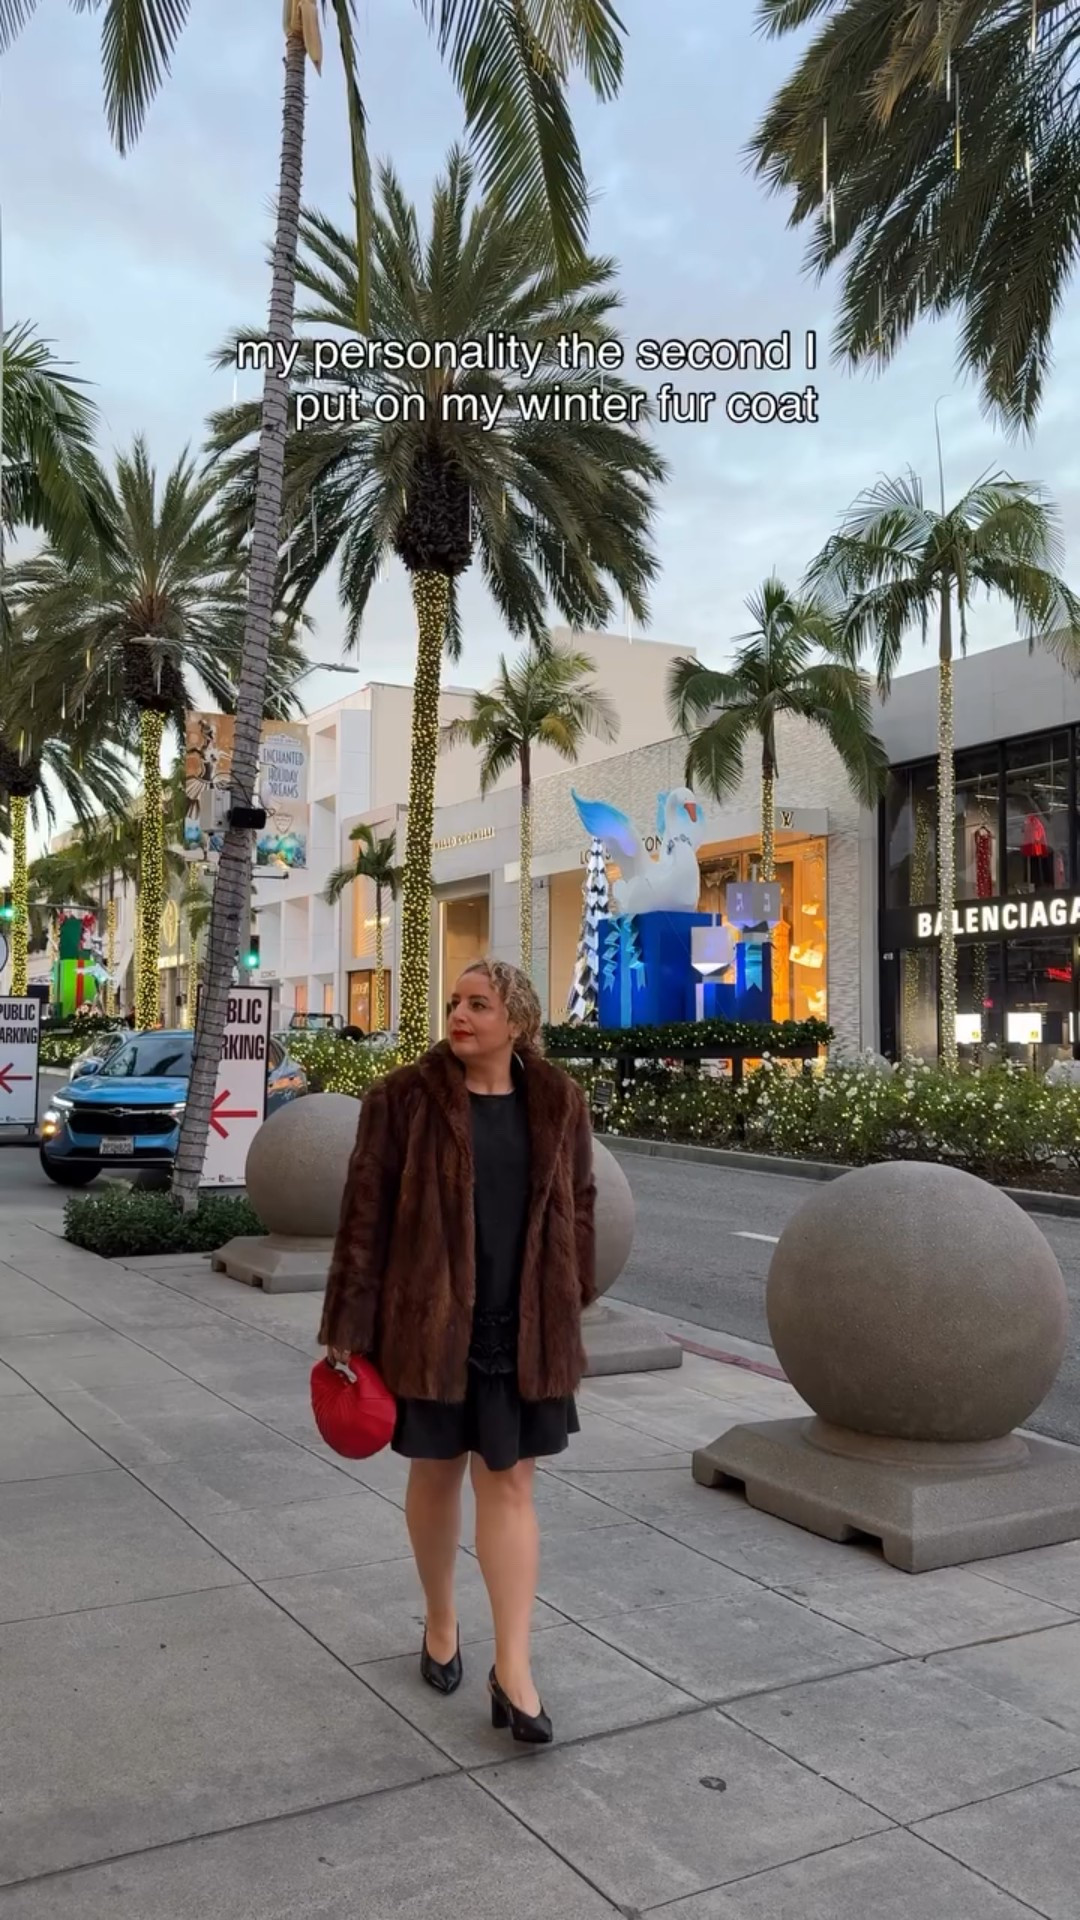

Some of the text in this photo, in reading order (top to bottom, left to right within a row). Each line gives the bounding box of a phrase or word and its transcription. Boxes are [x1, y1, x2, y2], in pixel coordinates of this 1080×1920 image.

[263, 748, 304, 766] ENCHANTED
[268, 767, 299, 783] HOLIDAY
[917, 897, 1080, 938] BALENCIAGA
[226, 998, 262, 1025] BLIC
[0, 1027, 38, 1044] ARKING
[221, 1034, 265, 1061] RKING
